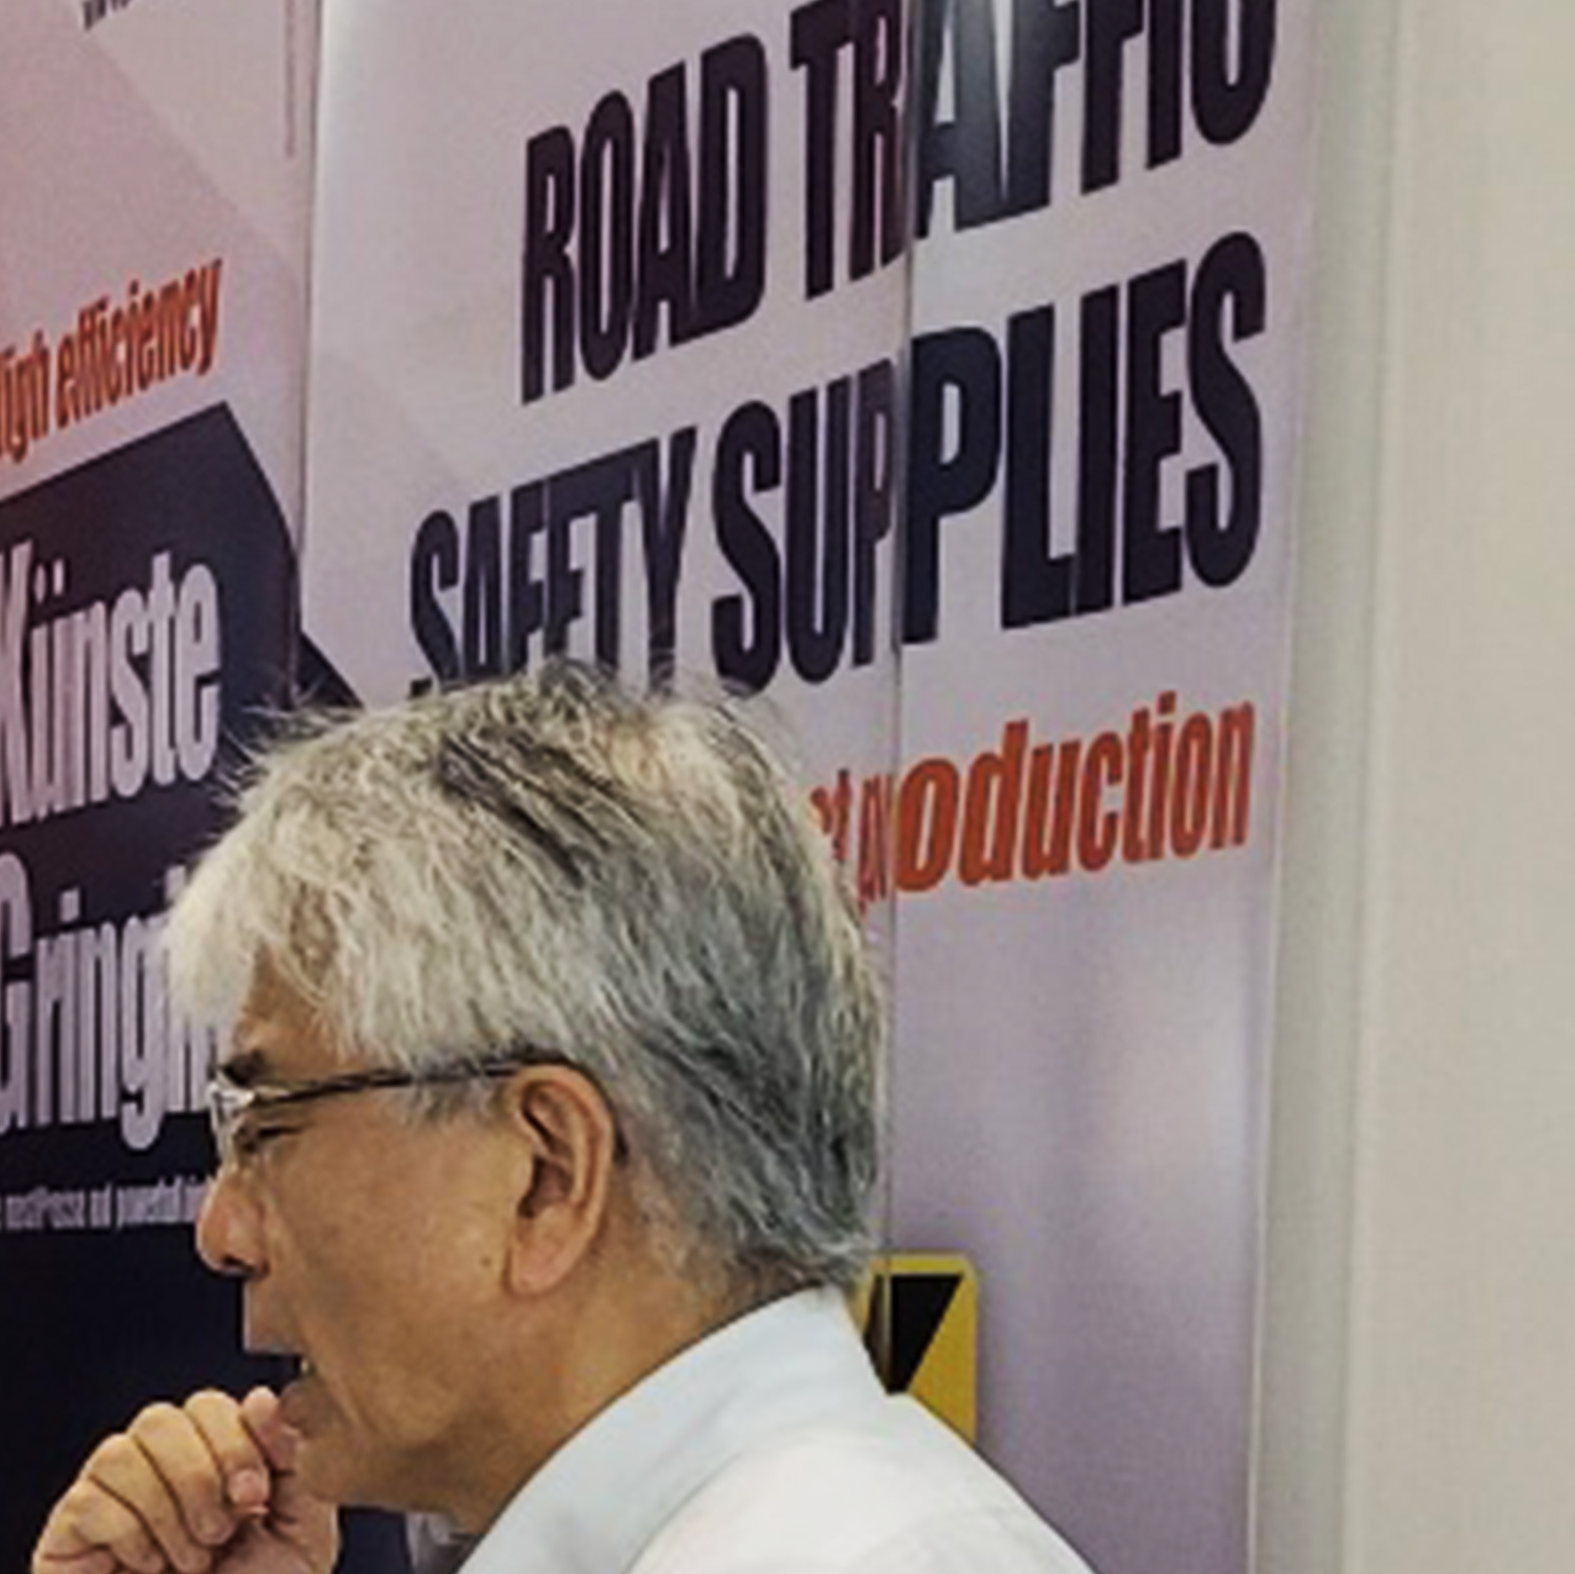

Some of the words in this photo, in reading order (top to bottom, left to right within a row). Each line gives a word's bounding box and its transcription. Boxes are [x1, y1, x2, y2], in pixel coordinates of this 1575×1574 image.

[56, 258, 222, 428] efficiency
[521, 33, 767, 405] ROAD
[710, 232, 1265, 695] SUPPLIES
